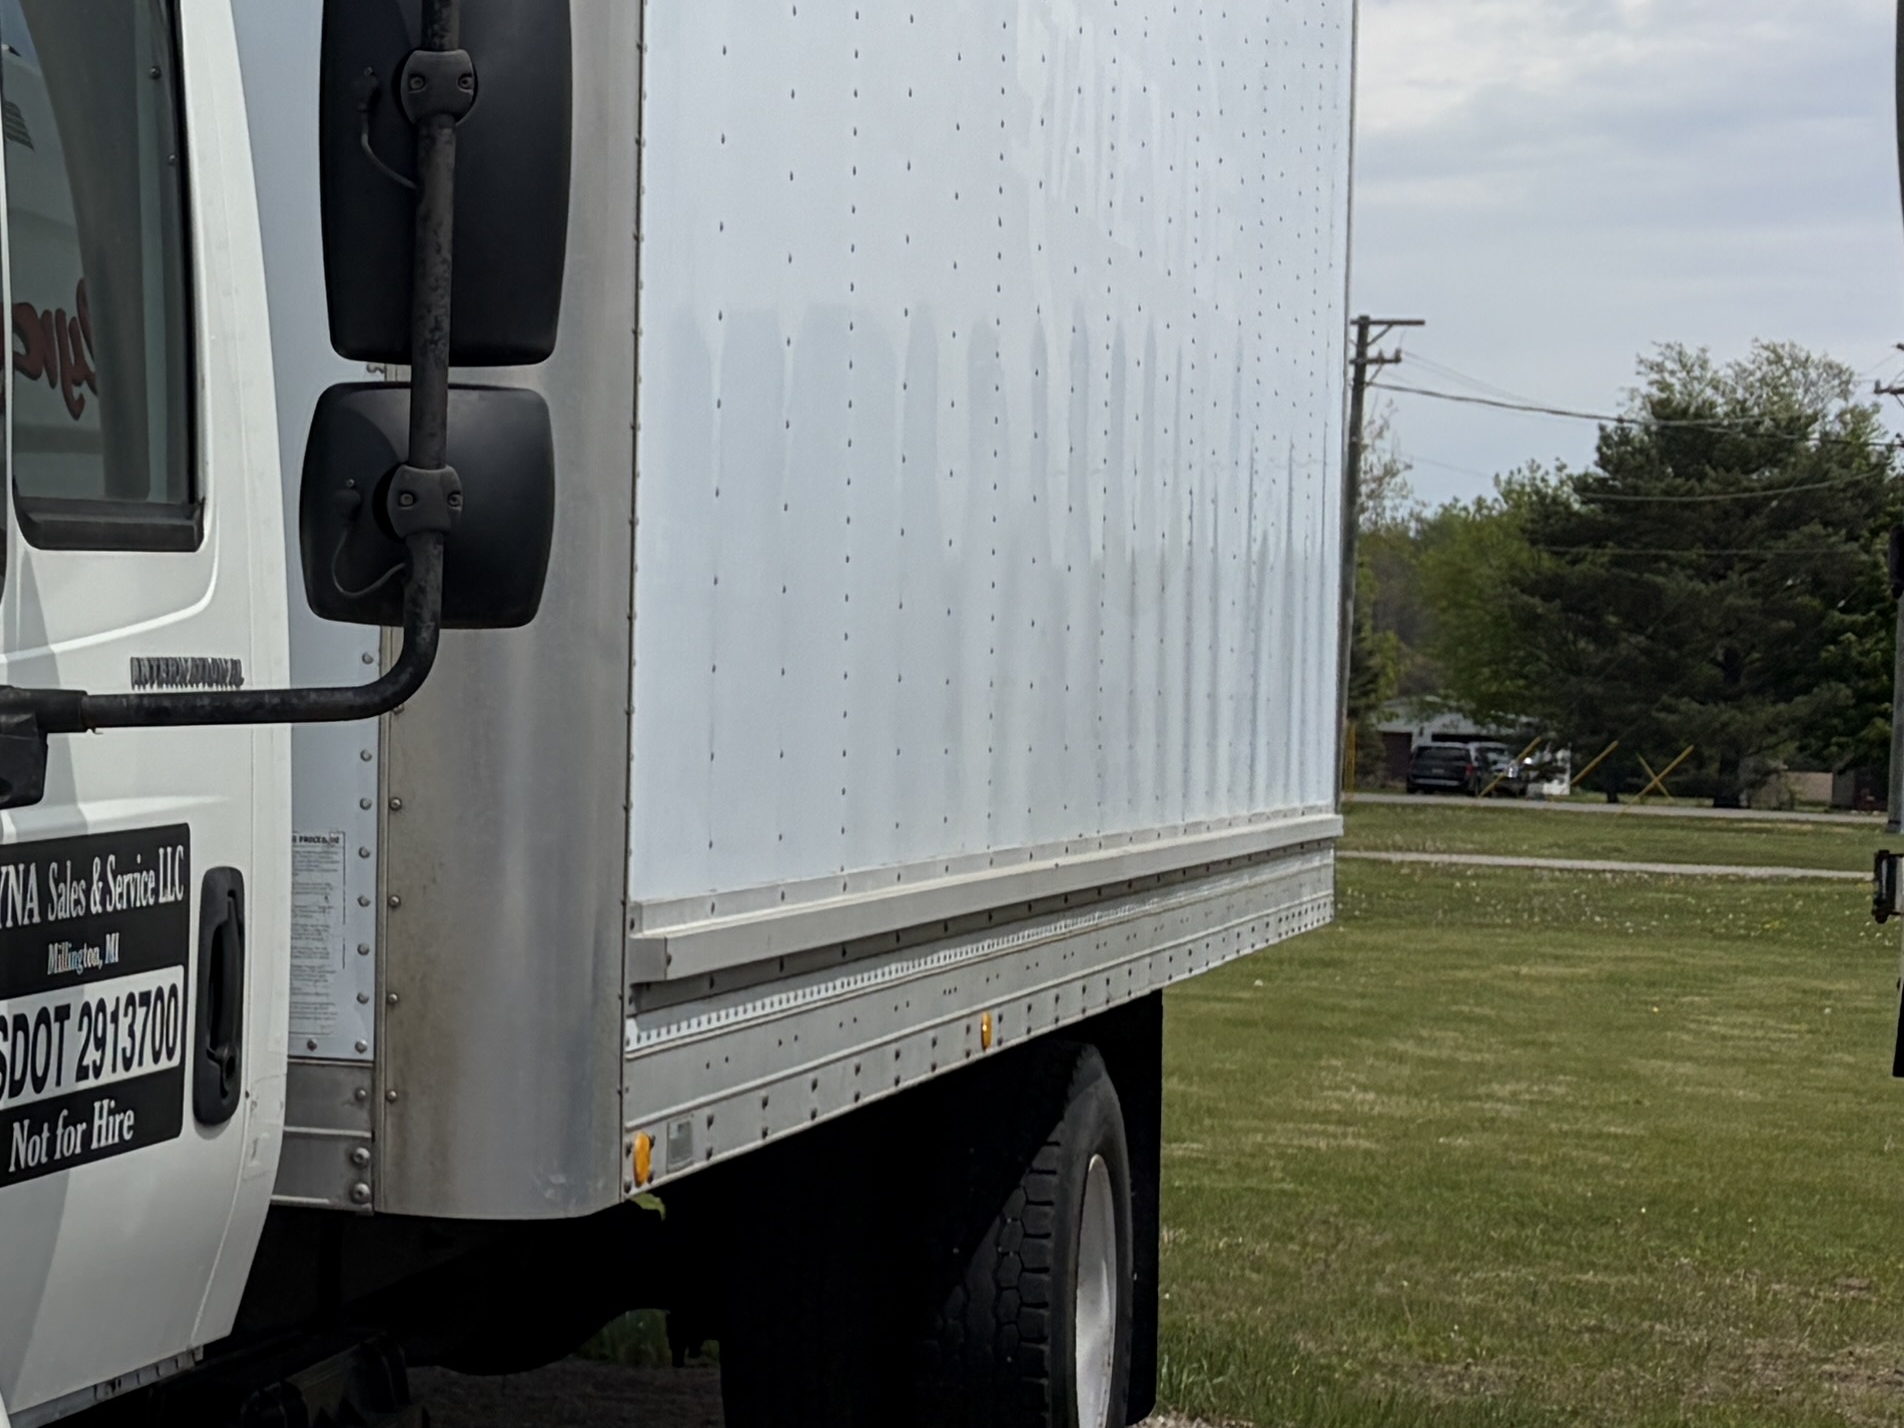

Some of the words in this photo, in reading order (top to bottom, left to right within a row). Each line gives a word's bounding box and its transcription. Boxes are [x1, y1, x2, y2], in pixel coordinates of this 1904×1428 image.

[47, 859, 86, 922] Sales
[90, 856, 103, 915] &
[106, 853, 155, 913] Service
[158, 844, 185, 904] LLC
[47, 941, 103, 976] Millington,
[105, 932, 120, 964] MI
[75, 982, 180, 1083] 2913700
[8, 1118, 50, 1173] Not
[53, 1108, 88, 1161] for
[90, 1098, 135, 1150] Hire
